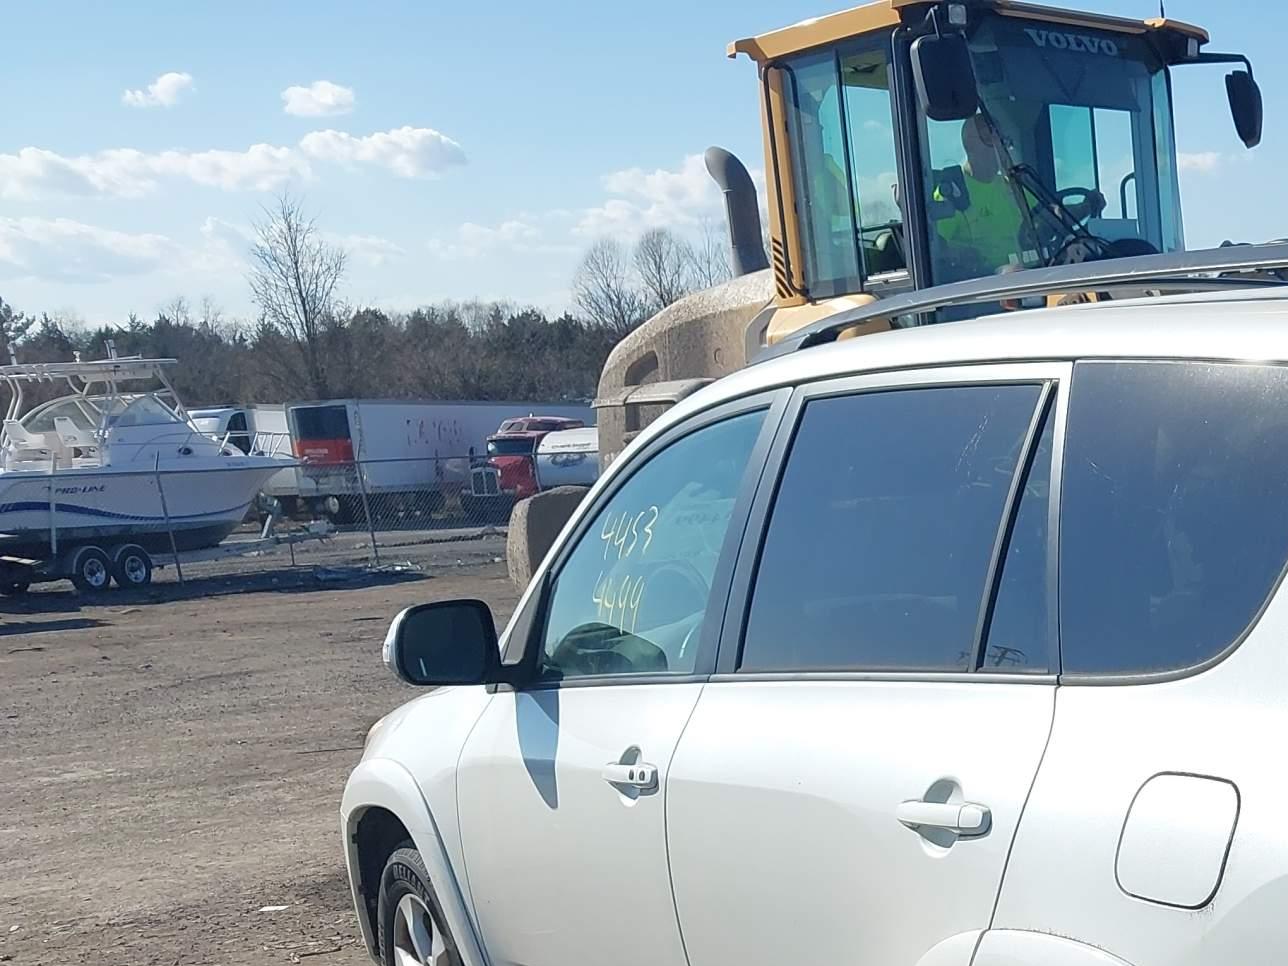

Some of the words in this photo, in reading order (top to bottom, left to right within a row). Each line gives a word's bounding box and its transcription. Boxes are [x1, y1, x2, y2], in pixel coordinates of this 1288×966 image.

[1024, 28, 1118, 56] VOLVO
[601, 505, 659, 561] 4453
[592, 570, 645, 636] 4499
